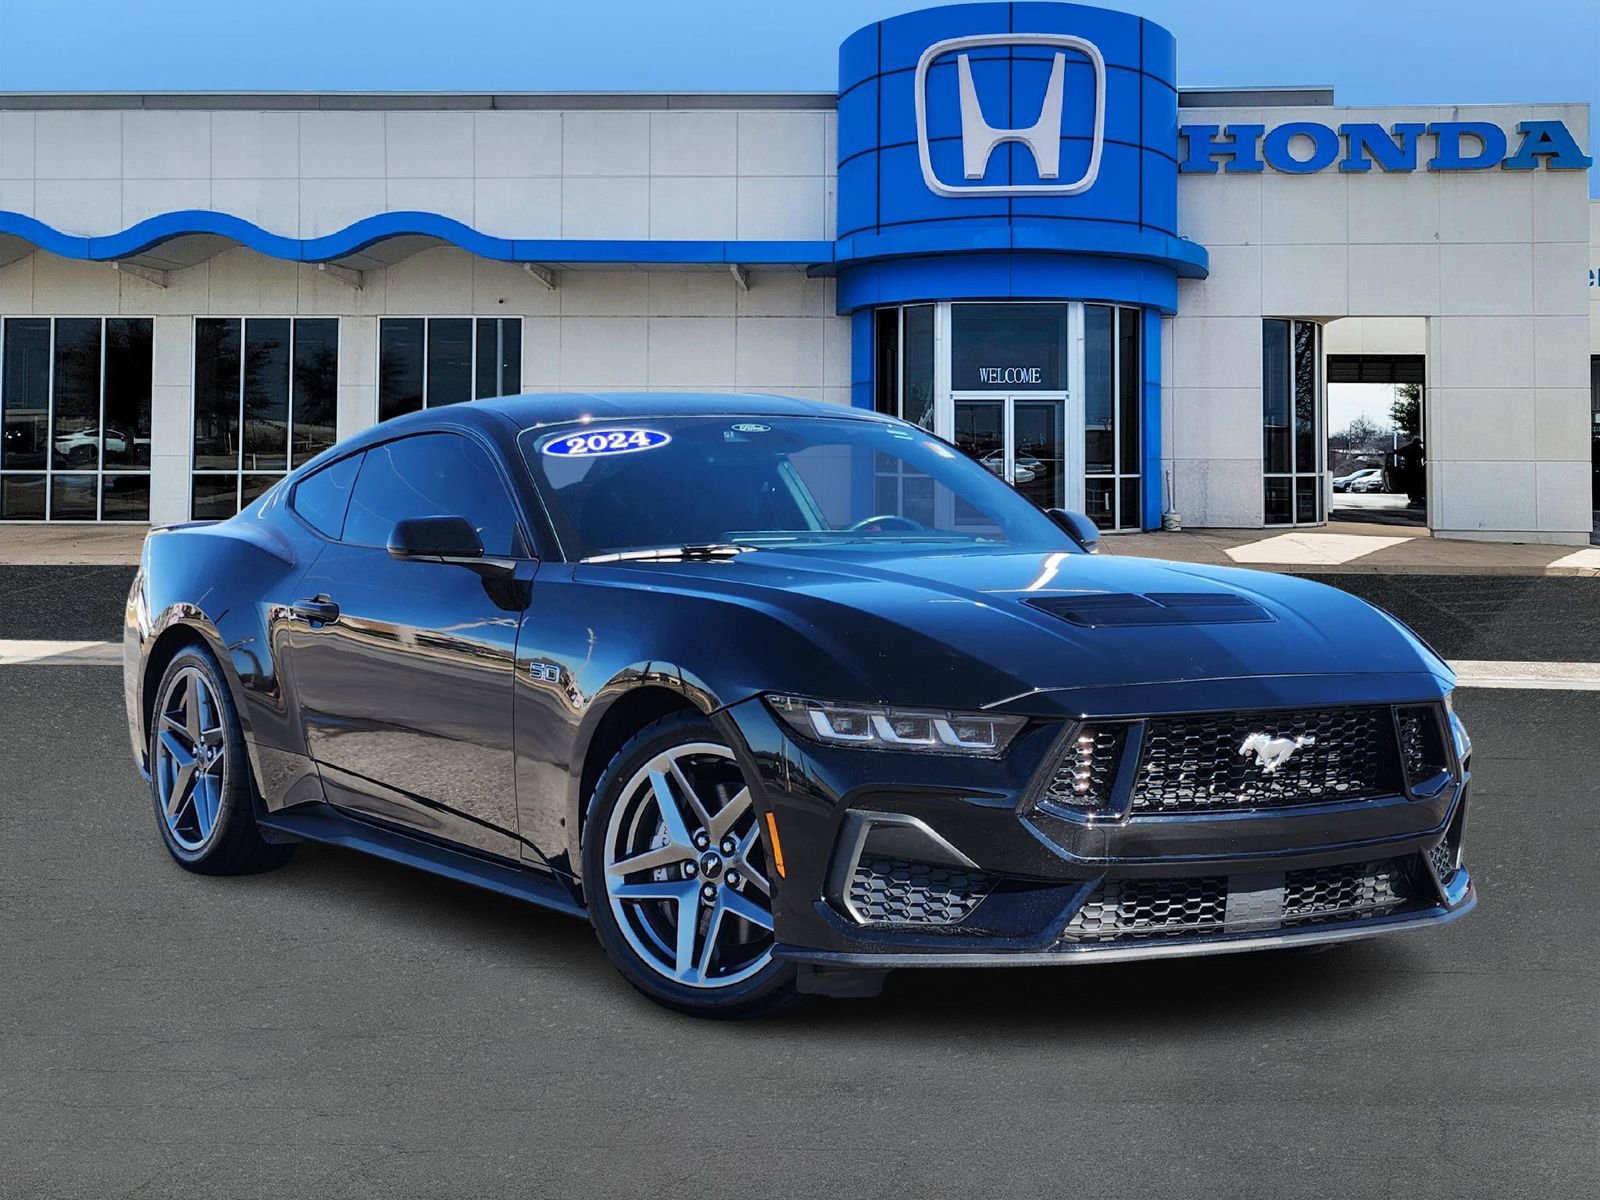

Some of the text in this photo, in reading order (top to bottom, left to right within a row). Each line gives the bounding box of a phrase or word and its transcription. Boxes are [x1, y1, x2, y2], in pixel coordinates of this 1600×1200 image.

[1178, 121, 1593, 174] HONDA
[979, 367, 1042, 384] WELCOME
[566, 431, 651, 455] 2024
